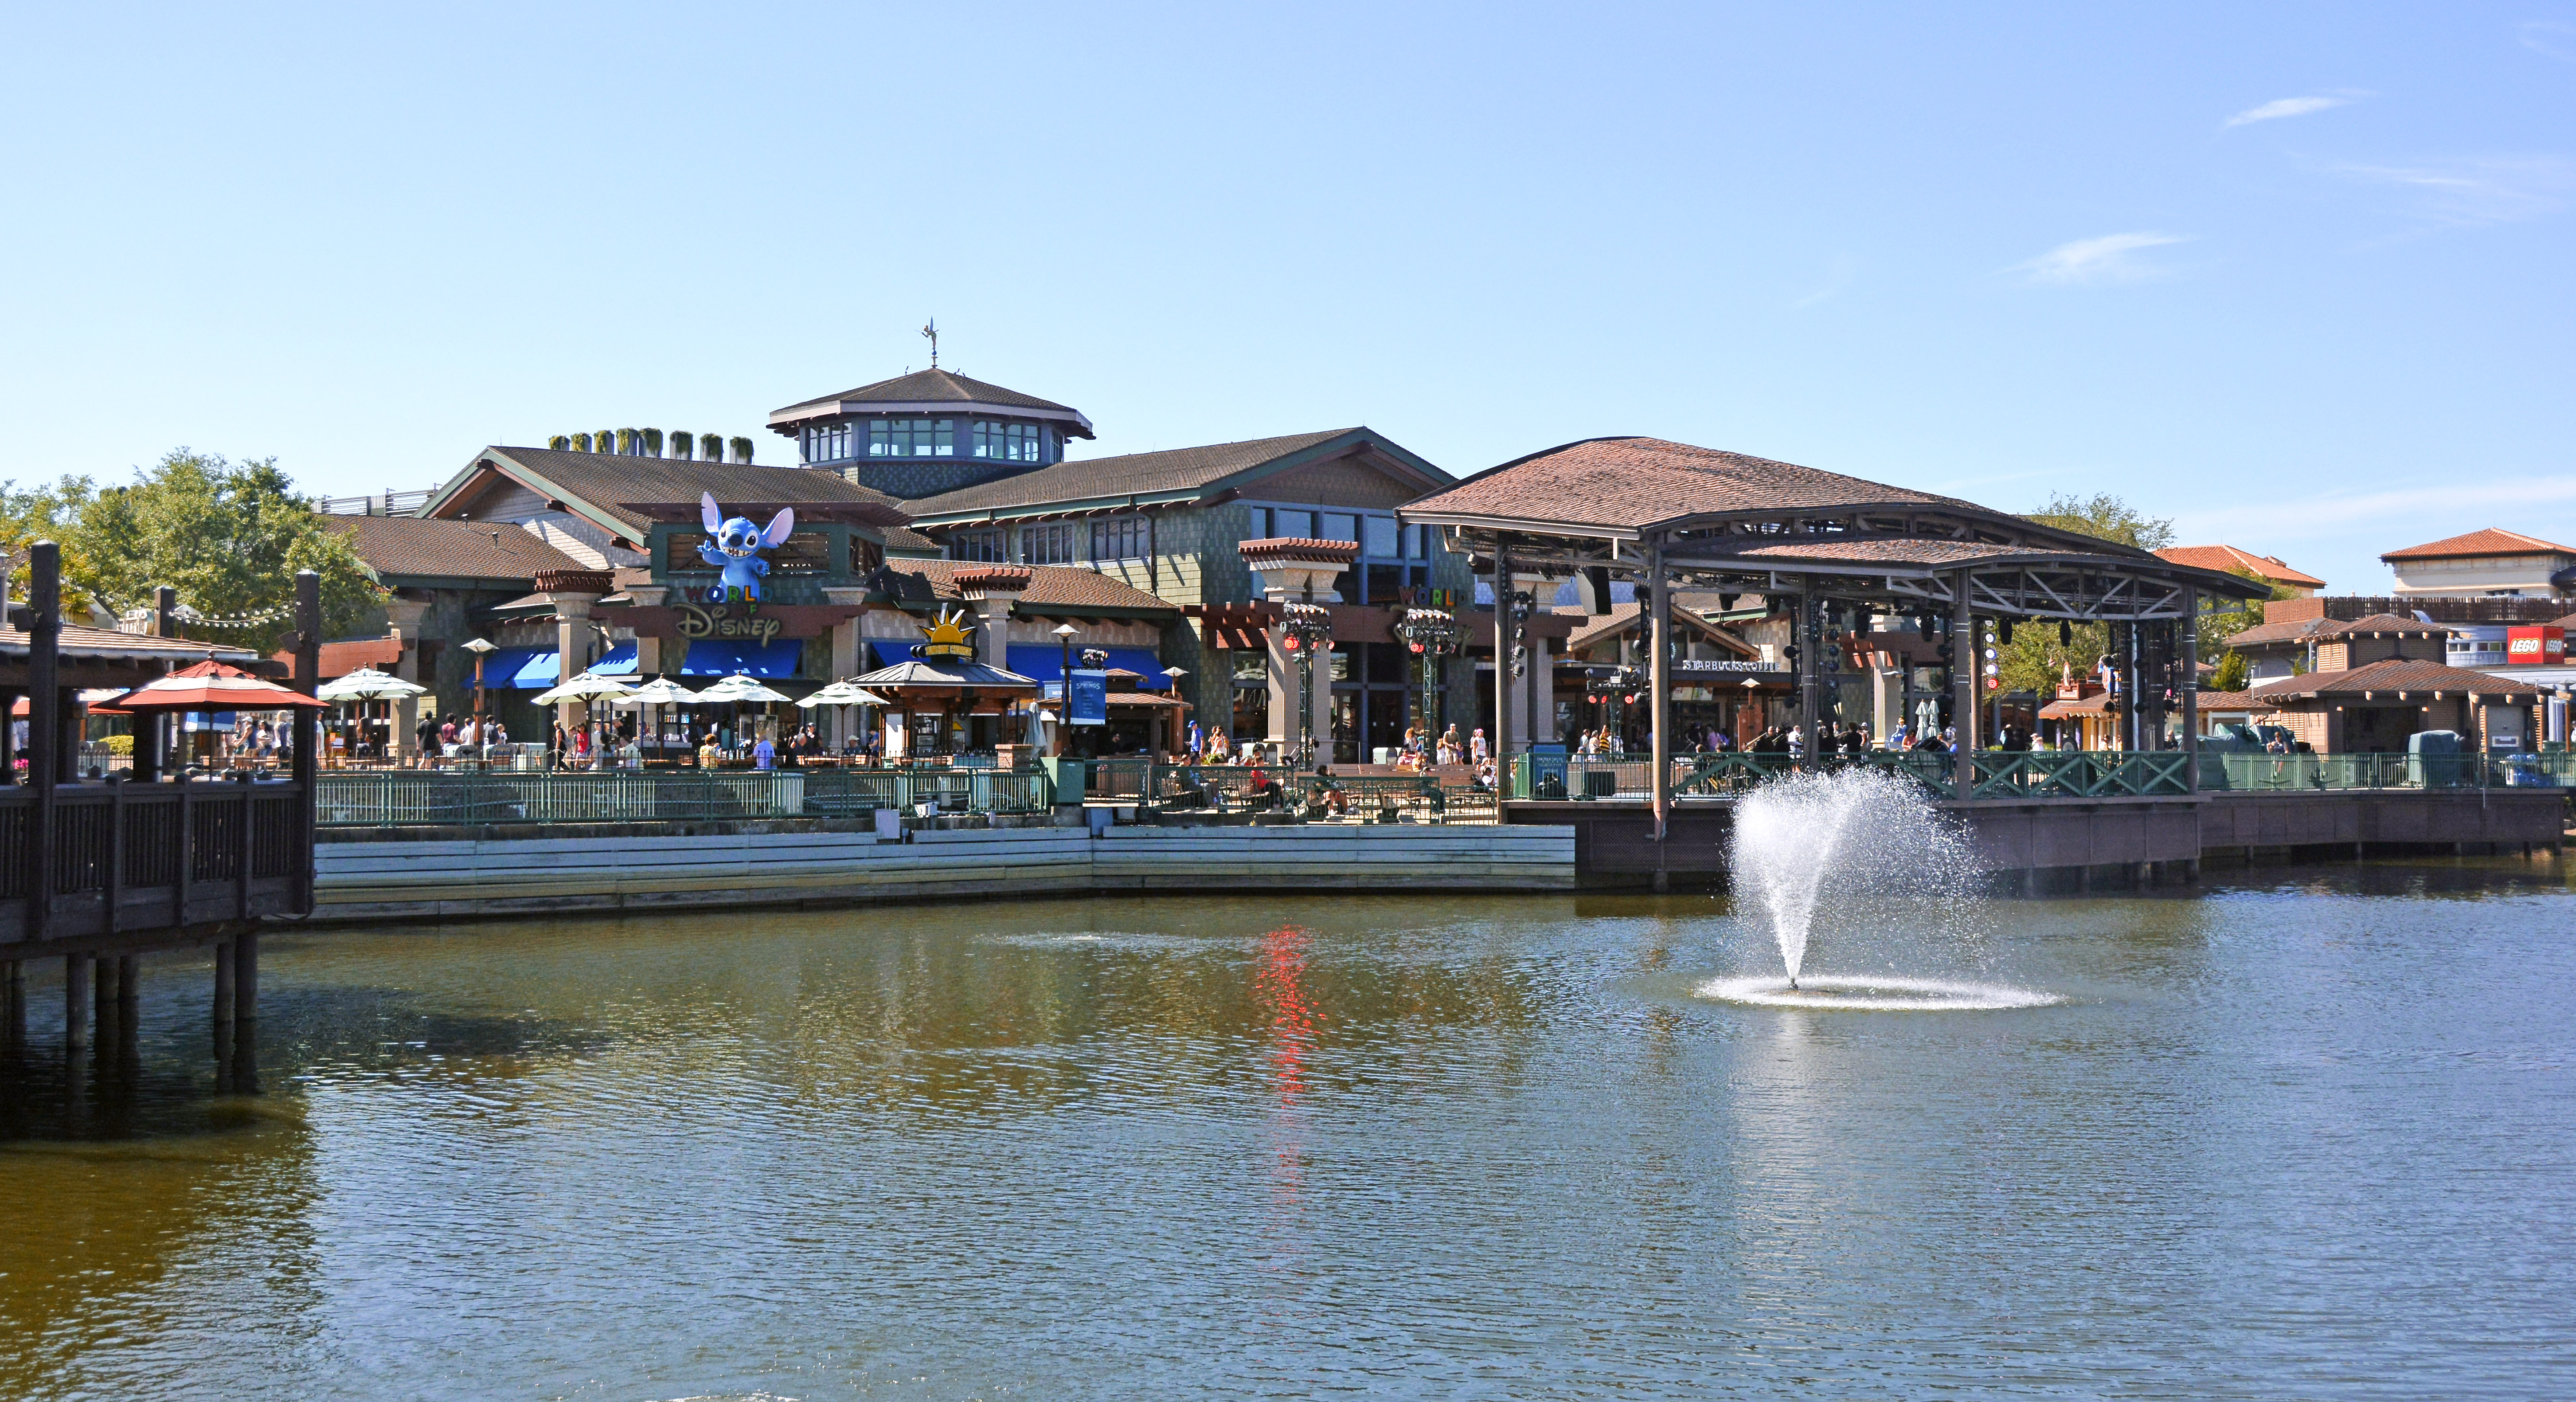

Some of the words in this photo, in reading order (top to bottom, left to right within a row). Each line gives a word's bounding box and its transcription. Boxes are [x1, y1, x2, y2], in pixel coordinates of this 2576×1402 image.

[684, 585, 774, 603] WORLD
[1398, 586, 1468, 607] WORLD
[737, 604, 756, 614] OF
[2510, 638, 2540, 653] LEGO
[2546, 639, 2562, 653] LEGO
[1683, 660, 1743, 670] STARBUCKS
[1744, 662, 1780, 671] COFFEE
